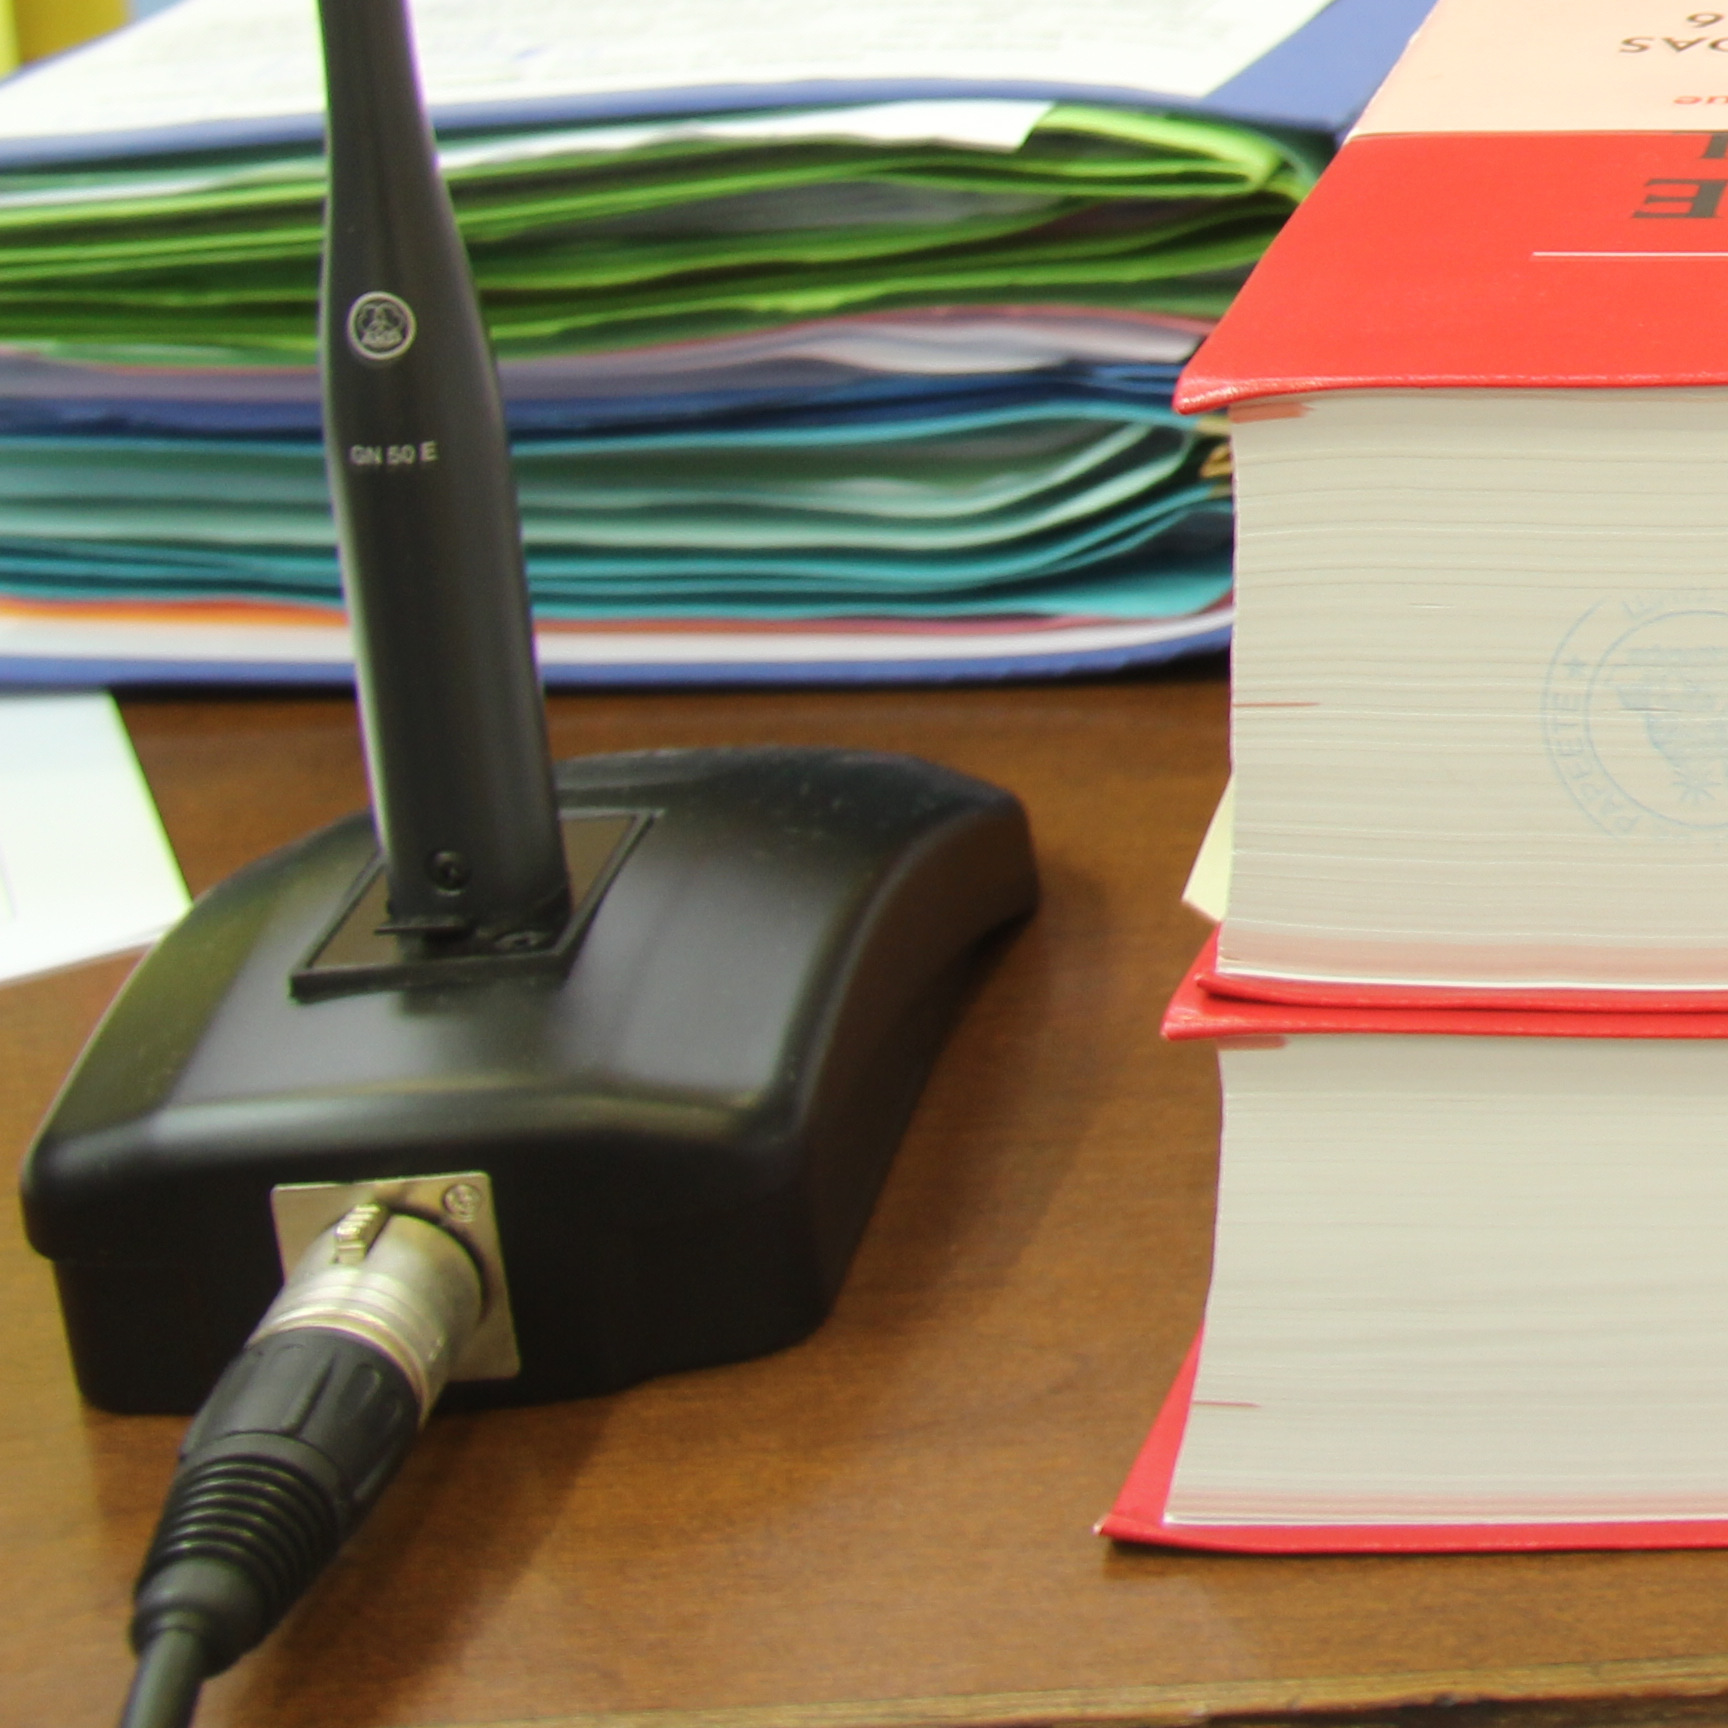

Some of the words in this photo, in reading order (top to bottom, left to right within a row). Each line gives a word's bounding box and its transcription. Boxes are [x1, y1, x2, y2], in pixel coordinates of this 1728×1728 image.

[350, 444, 383, 466] GN
[387, 444, 416, 466] 50
[419, 440, 439, 463] E
